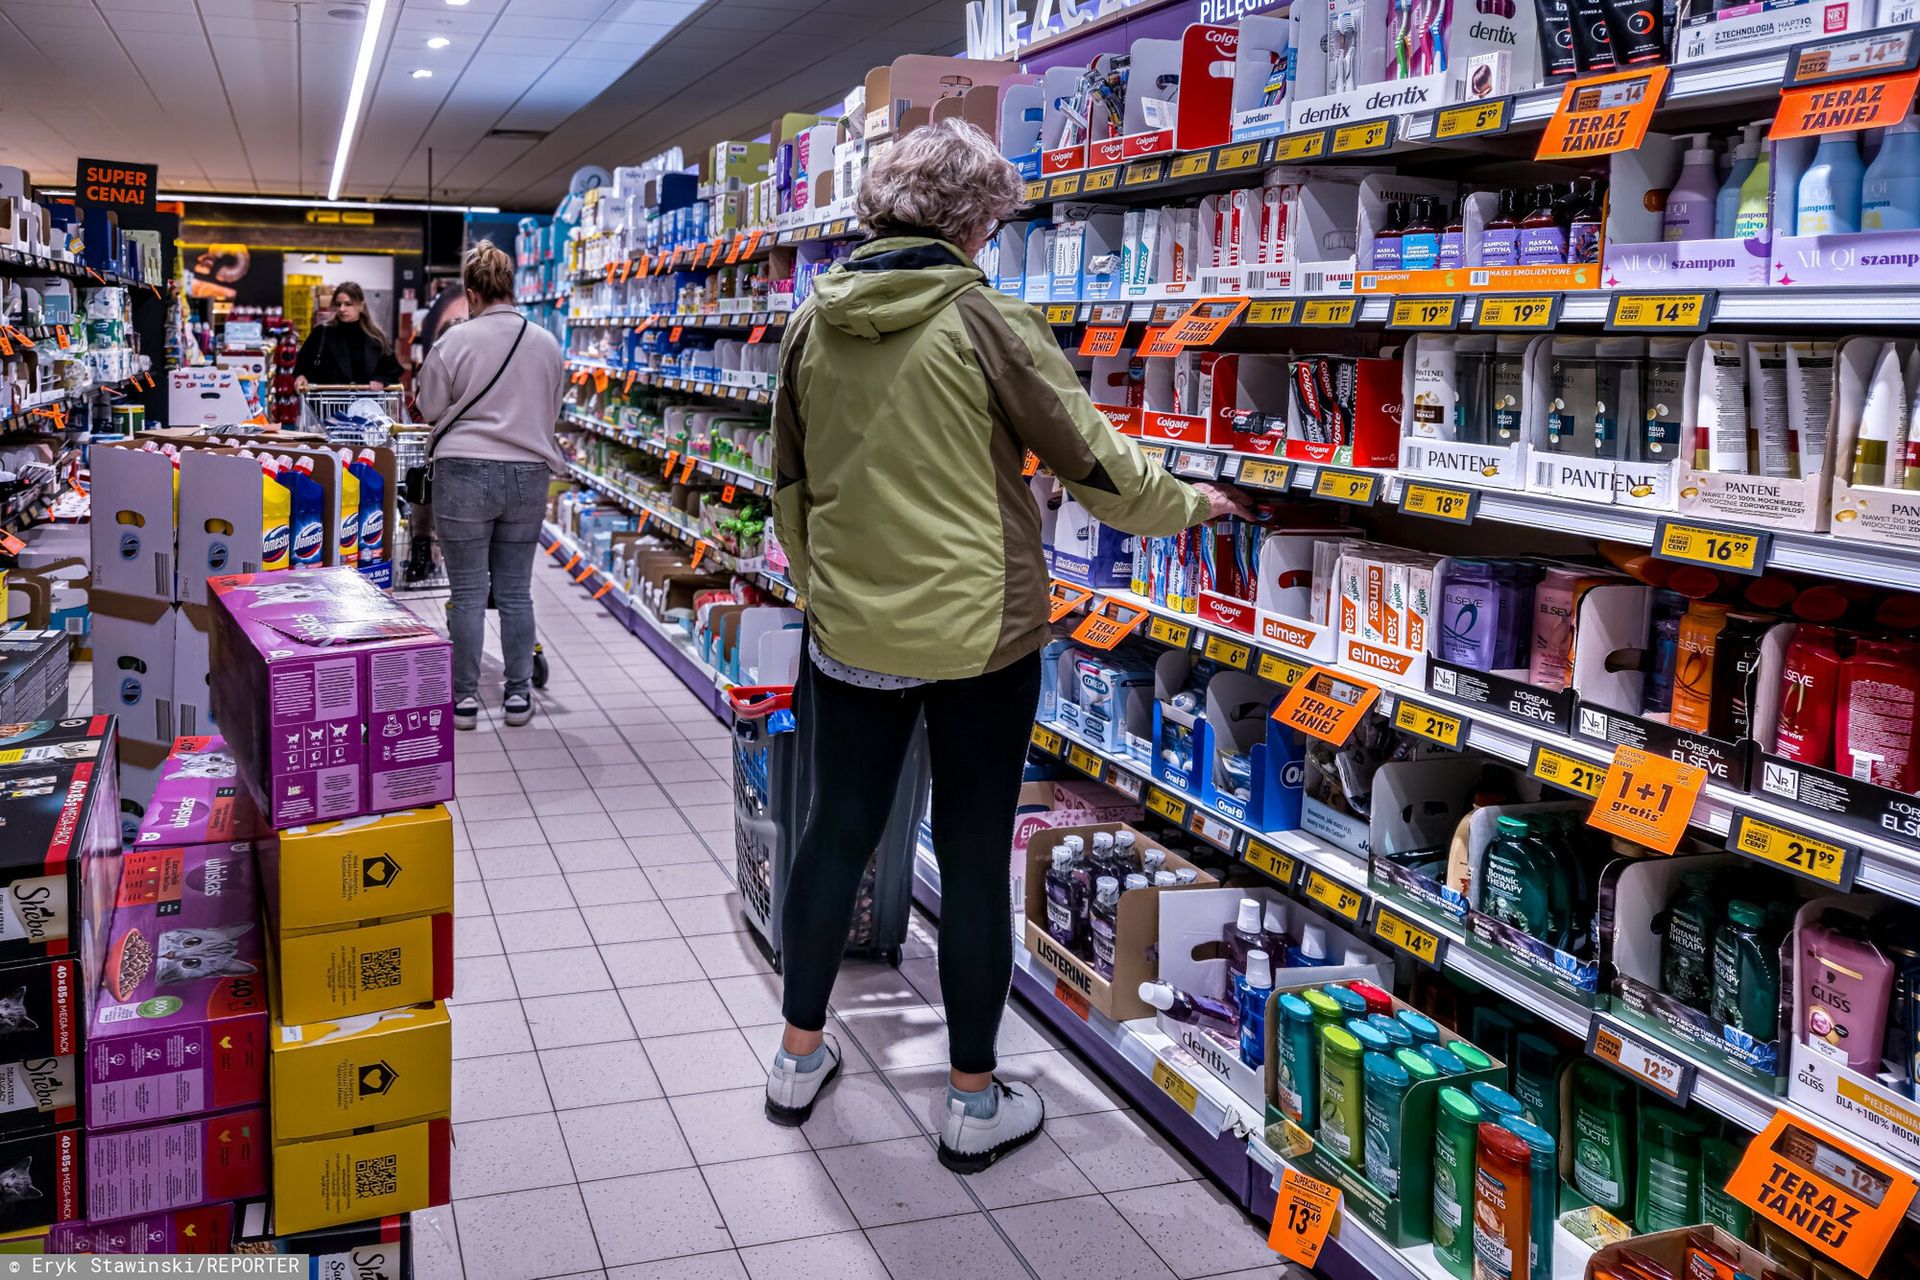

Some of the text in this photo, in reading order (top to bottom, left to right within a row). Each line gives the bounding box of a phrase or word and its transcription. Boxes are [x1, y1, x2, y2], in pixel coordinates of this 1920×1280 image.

[1469, 21, 1517, 46] dentix
[1722, 22, 1774, 38] TECHNOLOGIA
[1366, 86, 1429, 110] dentix
[1810, 84, 1886, 112] TERAZ
[1300, 103, 1351, 124] dentix
[1568, 110, 1631, 135] TERAZ
[1802, 104, 1880, 131] TANIEJ
[1136, 135, 1158, 145] Colgate
[1562, 130, 1624, 152] TANIEJ
[1051, 152, 1074, 162] Colgate
[87, 167, 147, 188] SUPER
[86, 185, 146, 205] CENA!
[1514, 268, 1571, 276] EMOLIENTOWE
[1672, 258, 1736, 270] szampon
[1175, 330, 1211, 342] TANIEJ
[1183, 320, 1218, 332] TERAZ
[1090, 342, 1113, 352] TANIEJ
[1094, 332, 1117, 342] TERAZ
[1150, 343, 1175, 352] TANIEJ
[1302, 367, 1316, 411] Colgate
[1157, 417, 1188, 429] Colgate
[1305, 445, 1329, 453] Colgate
[1428, 451, 1500, 475] PANTENE
[1562, 467, 1656, 495] PANTENE
[1726, 482, 1780, 497] PANTENE
[1702, 491, 1725, 499] NAWET
[1702, 498, 1805, 514] WIDOCZNIE ZDROWSZE WŁOSY
[1861, 520, 1907, 531] WIDOCZNIE
[1862, 514, 1891, 522] NAWET
[1350, 576, 1360, 602] JUNIOR
[1370, 570, 1381, 622] elmex
[1394, 583, 1403, 610] JUNIOR
[1210, 600, 1242, 617] Colgate
[1419, 588, 1428, 616] JUNIOR
[1091, 620, 1120, 635] TERAZ
[1265, 623, 1306, 646] elmex
[1351, 647, 1400, 671] elmex
[1299, 696, 1346, 722] TERAZ
[1510, 701, 1555, 724] ELSEVE
[1290, 709, 1336, 735] TANIEJ
[1678, 738, 1725, 759] L'ORÉAL
[1540, 766, 1556, 776] CENY
[1672, 750, 1728, 778] ELSEVE
[1165, 770, 1186, 787] Oral-B
[1773, 784, 1795, 795] POLSCE
[1218, 800, 1244, 819] Oral-B
[1744, 839, 1767, 850] CENY
[1746, 833, 1767, 845] NISKIE
[1486, 875, 1523, 894] THERAPY
[14, 885, 51, 938] Sheba
[1669, 932, 1706, 954] THERAPY
[1037, 940, 1093, 996] LISTERINE
[1811, 985, 1851, 1014] GLISS
[1597, 1043, 1617, 1058] CENA
[1599, 1036, 1619, 1049] SUPER
[1183, 1032, 1230, 1081] dentix
[23, 1058, 54, 1107] Sheba
[1798, 1073, 1825, 1093] GLISS
[1836, 1095, 1853, 1111] DLA
[1856, 1107, 1890, 1130] +100%
[1577, 1122, 1610, 1146] FRUCTIS
[1766, 1162, 1861, 1229] TERAZ
[1757, 1183, 1849, 1249] TANIEJ
